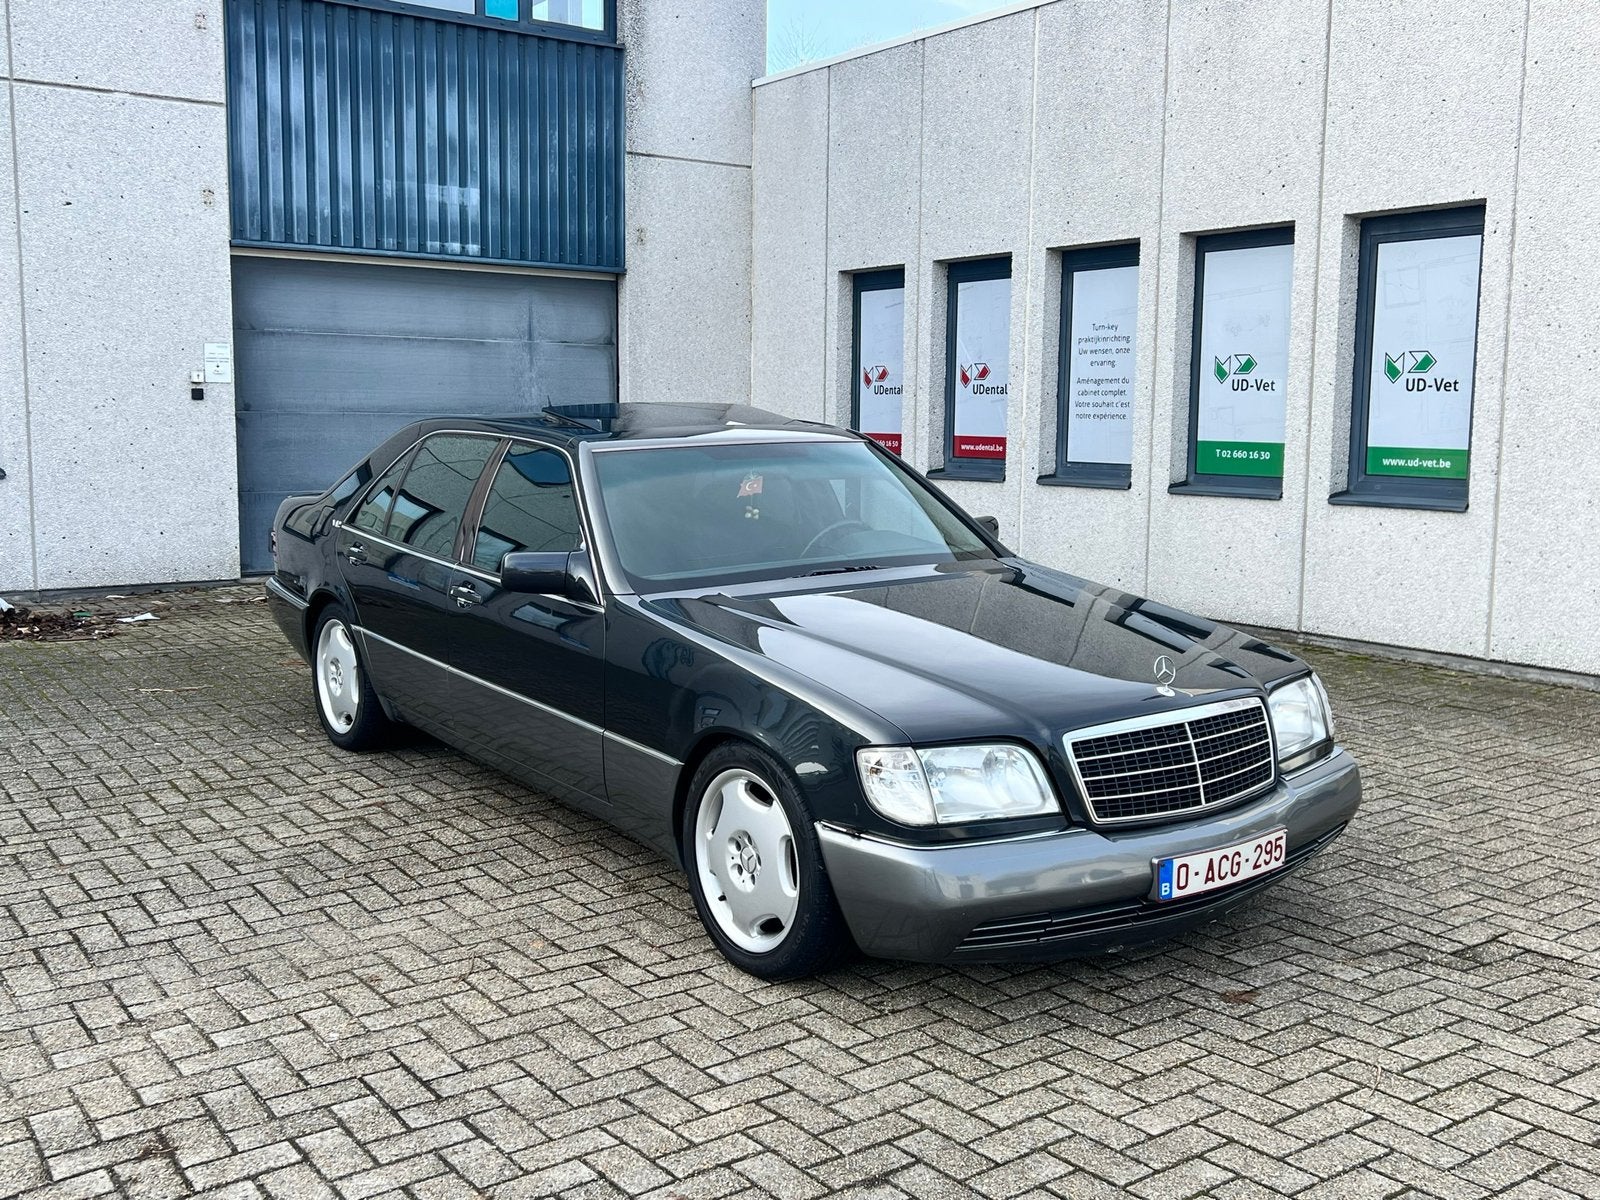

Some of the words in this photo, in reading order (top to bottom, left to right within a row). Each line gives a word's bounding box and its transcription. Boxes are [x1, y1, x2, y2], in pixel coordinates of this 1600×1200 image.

[1092, 323, 1118, 332] Turn-key
[1121, 376, 1130, 384] du
[1231, 378, 1276, 392] UD-Vet
[1405, 378, 1459, 392] UD-Vet
[873, 384, 904, 396] UDental
[972, 383, 1008, 395] UDental
[1075, 400, 1091, 408] Votre
[1075, 412, 1091, 420] notre
[960, 443, 1004, 452] www.udental.be
[1215, 449, 1221, 458] T
[1221, 449, 1231, 459] 02
[1232, 449, 1247, 459] 660
[1248, 450, 1259, 460] 16
[1260, 450, 1271, 461] 30
[1382, 457, 1451, 469] www.ud-vet.be
[1161, 883, 1170, 896] B
